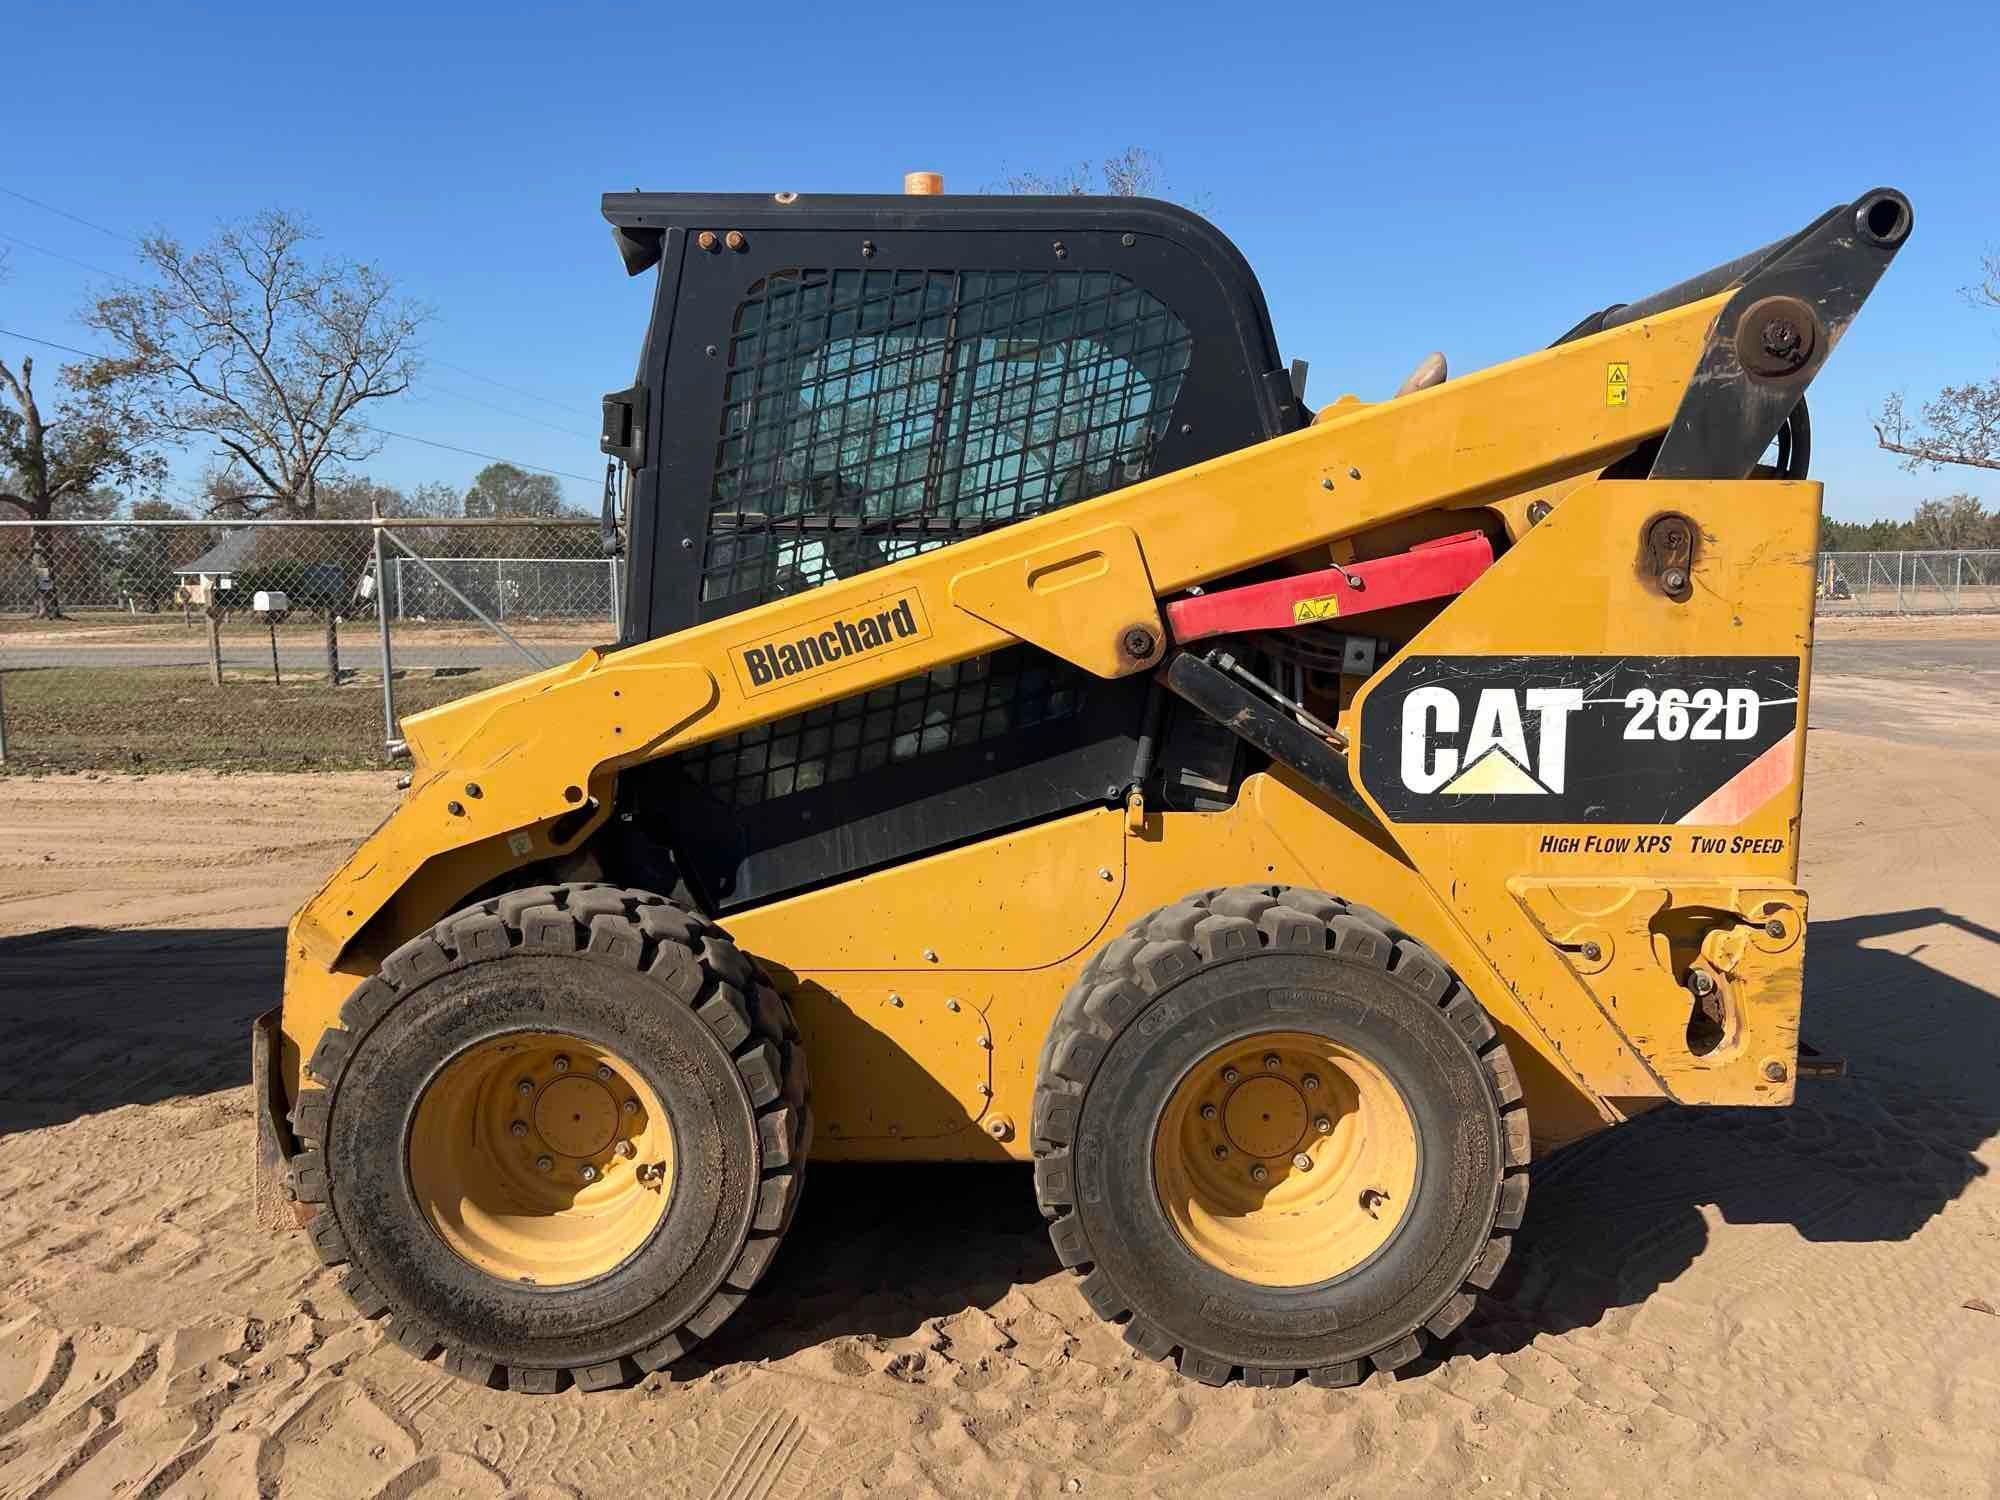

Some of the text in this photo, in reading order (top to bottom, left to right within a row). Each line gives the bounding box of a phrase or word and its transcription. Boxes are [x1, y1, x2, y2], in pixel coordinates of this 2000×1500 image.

[743, 599, 918, 687] Blanchard
[1401, 686, 1583, 795] CAT
[1623, 687, 1760, 742] 262D
[1634, 835, 1673, 854] XPS
